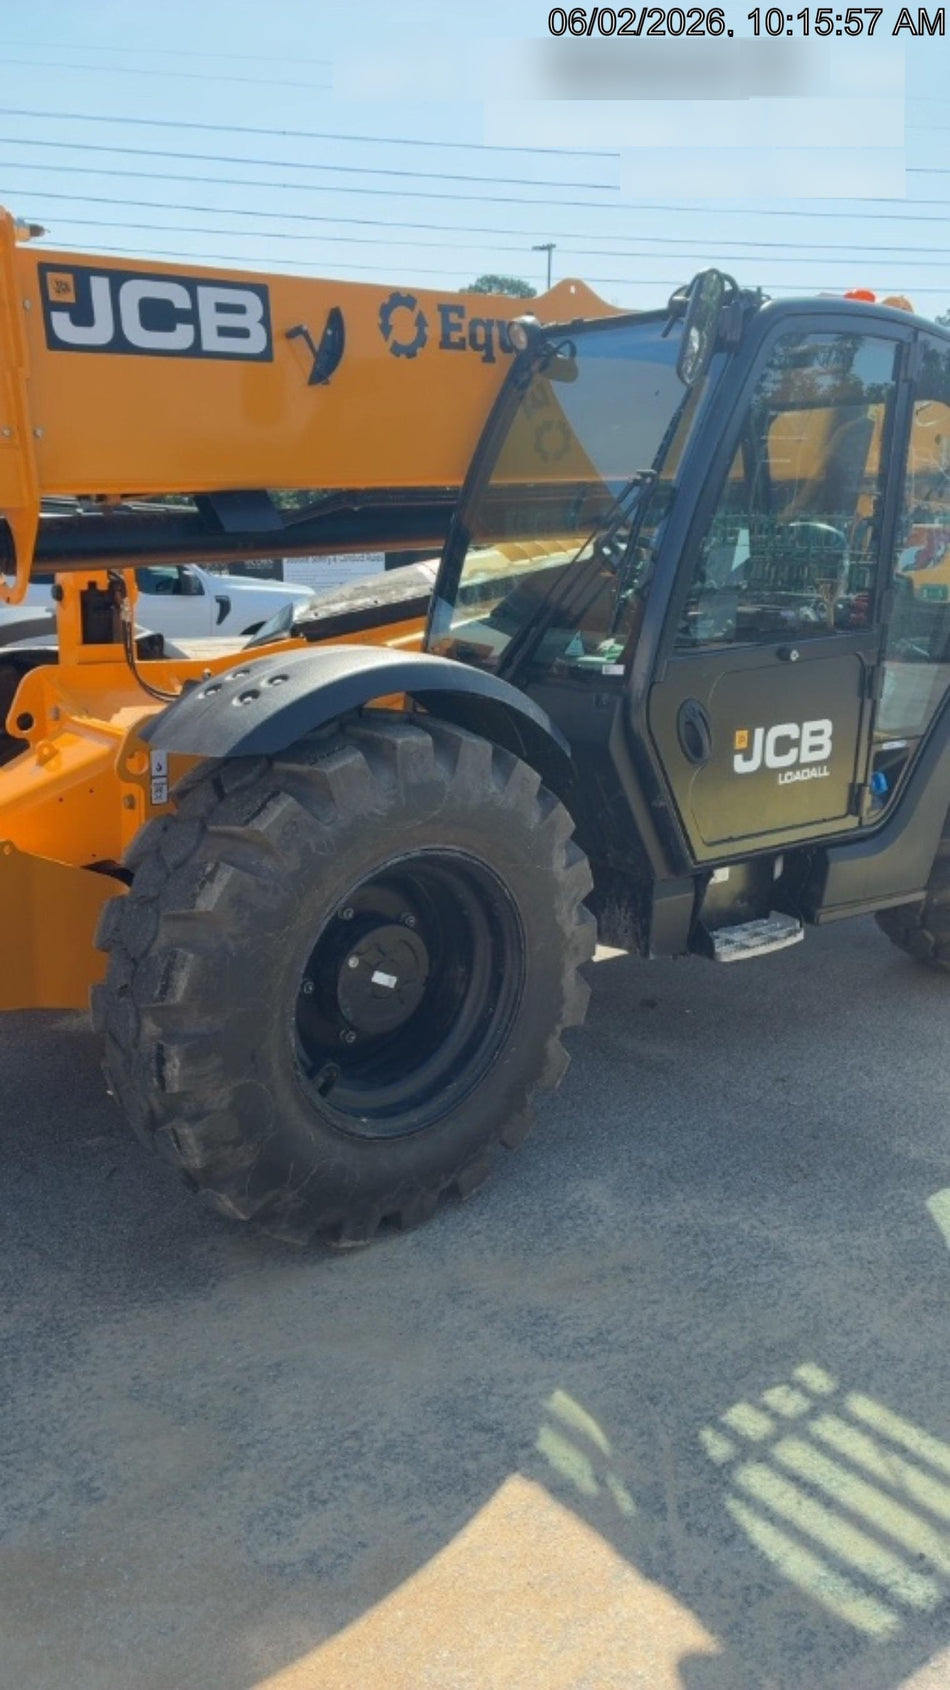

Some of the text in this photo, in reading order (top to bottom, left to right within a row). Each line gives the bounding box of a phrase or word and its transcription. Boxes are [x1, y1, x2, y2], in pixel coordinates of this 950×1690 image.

[51, 275, 268, 354] JCB
[437, 304, 534, 364] Equ
[733, 718, 833, 774] JCB
[778, 765, 830, 785] LOADALL
